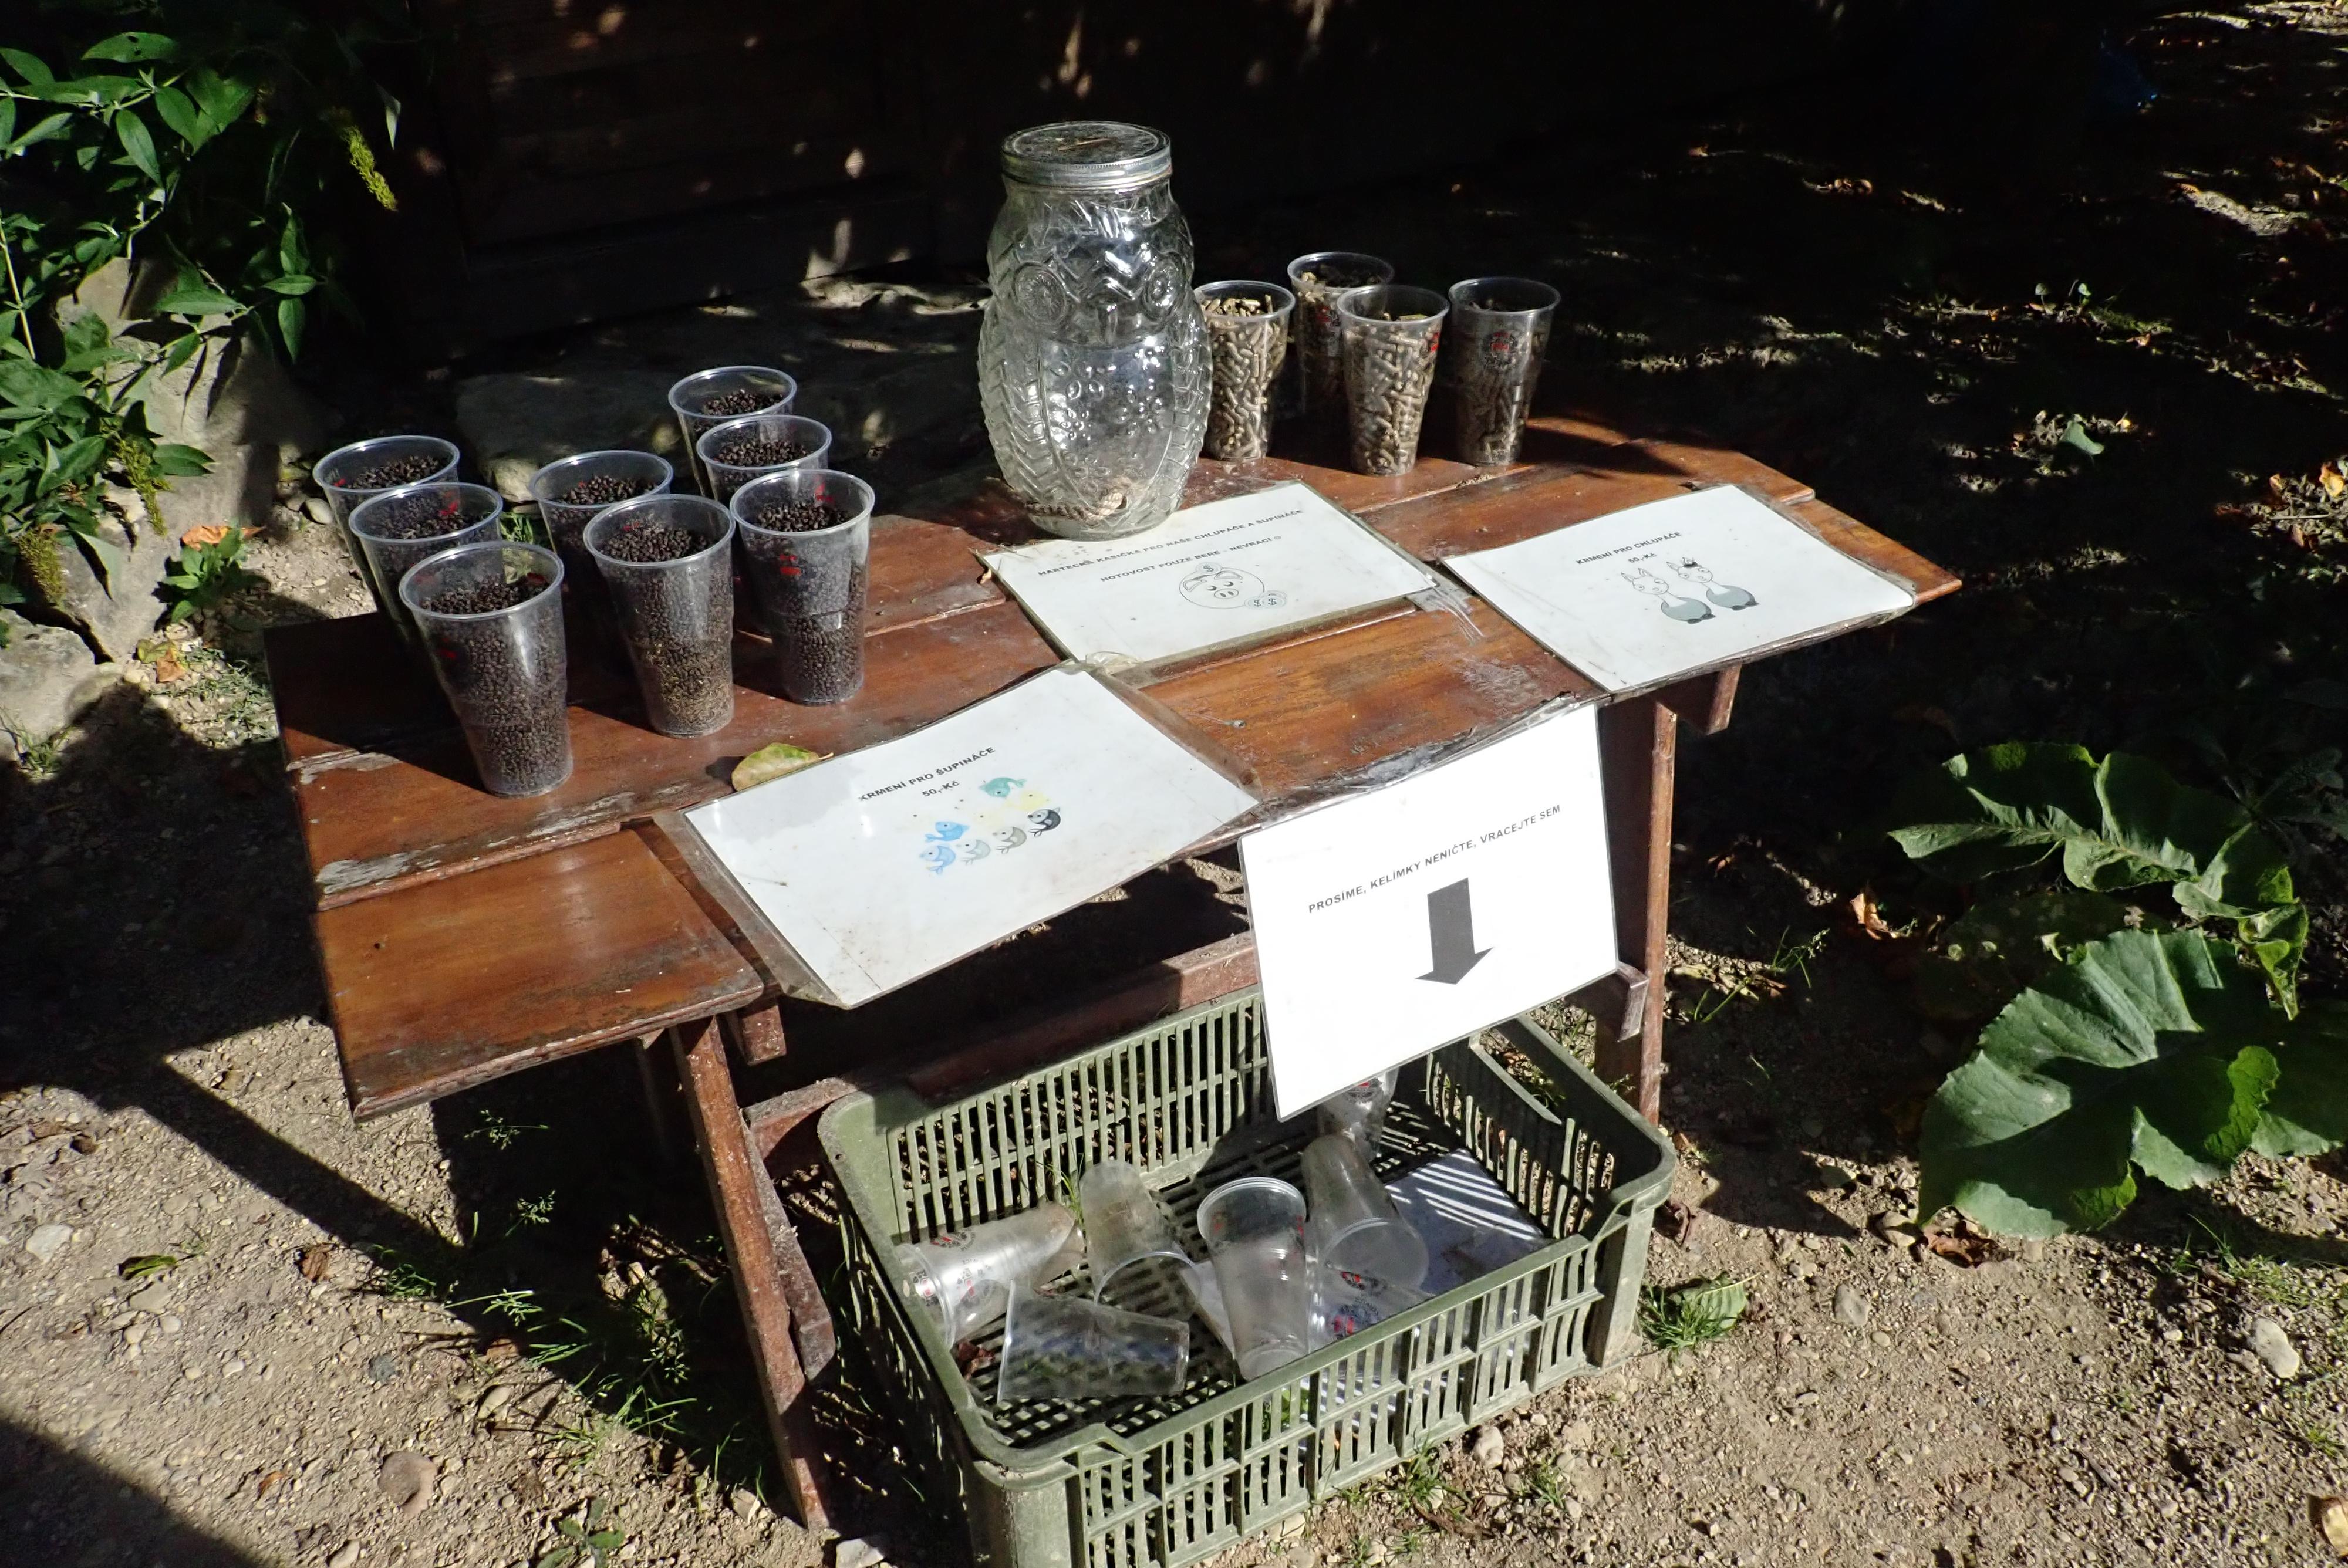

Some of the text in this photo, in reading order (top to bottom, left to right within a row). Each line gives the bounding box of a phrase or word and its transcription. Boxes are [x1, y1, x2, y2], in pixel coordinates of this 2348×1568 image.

[1576, 532, 1682, 565] KRMENÍ PRO CHLUPÁČE
[1100, 565, 1156, 582] HOTOVOST
[1158, 556, 1192, 568] POUZE
[1194, 550, 1221, 559] BERE
[858, 747, 996, 802] KRMENÍ PRO ŠUPINÁČE
[922, 780, 960, 797] 50,-Kč
[1308, 805, 1561, 913] PROSÍME, KELÍMKY NENIČTE, VRACEJTE SEM
